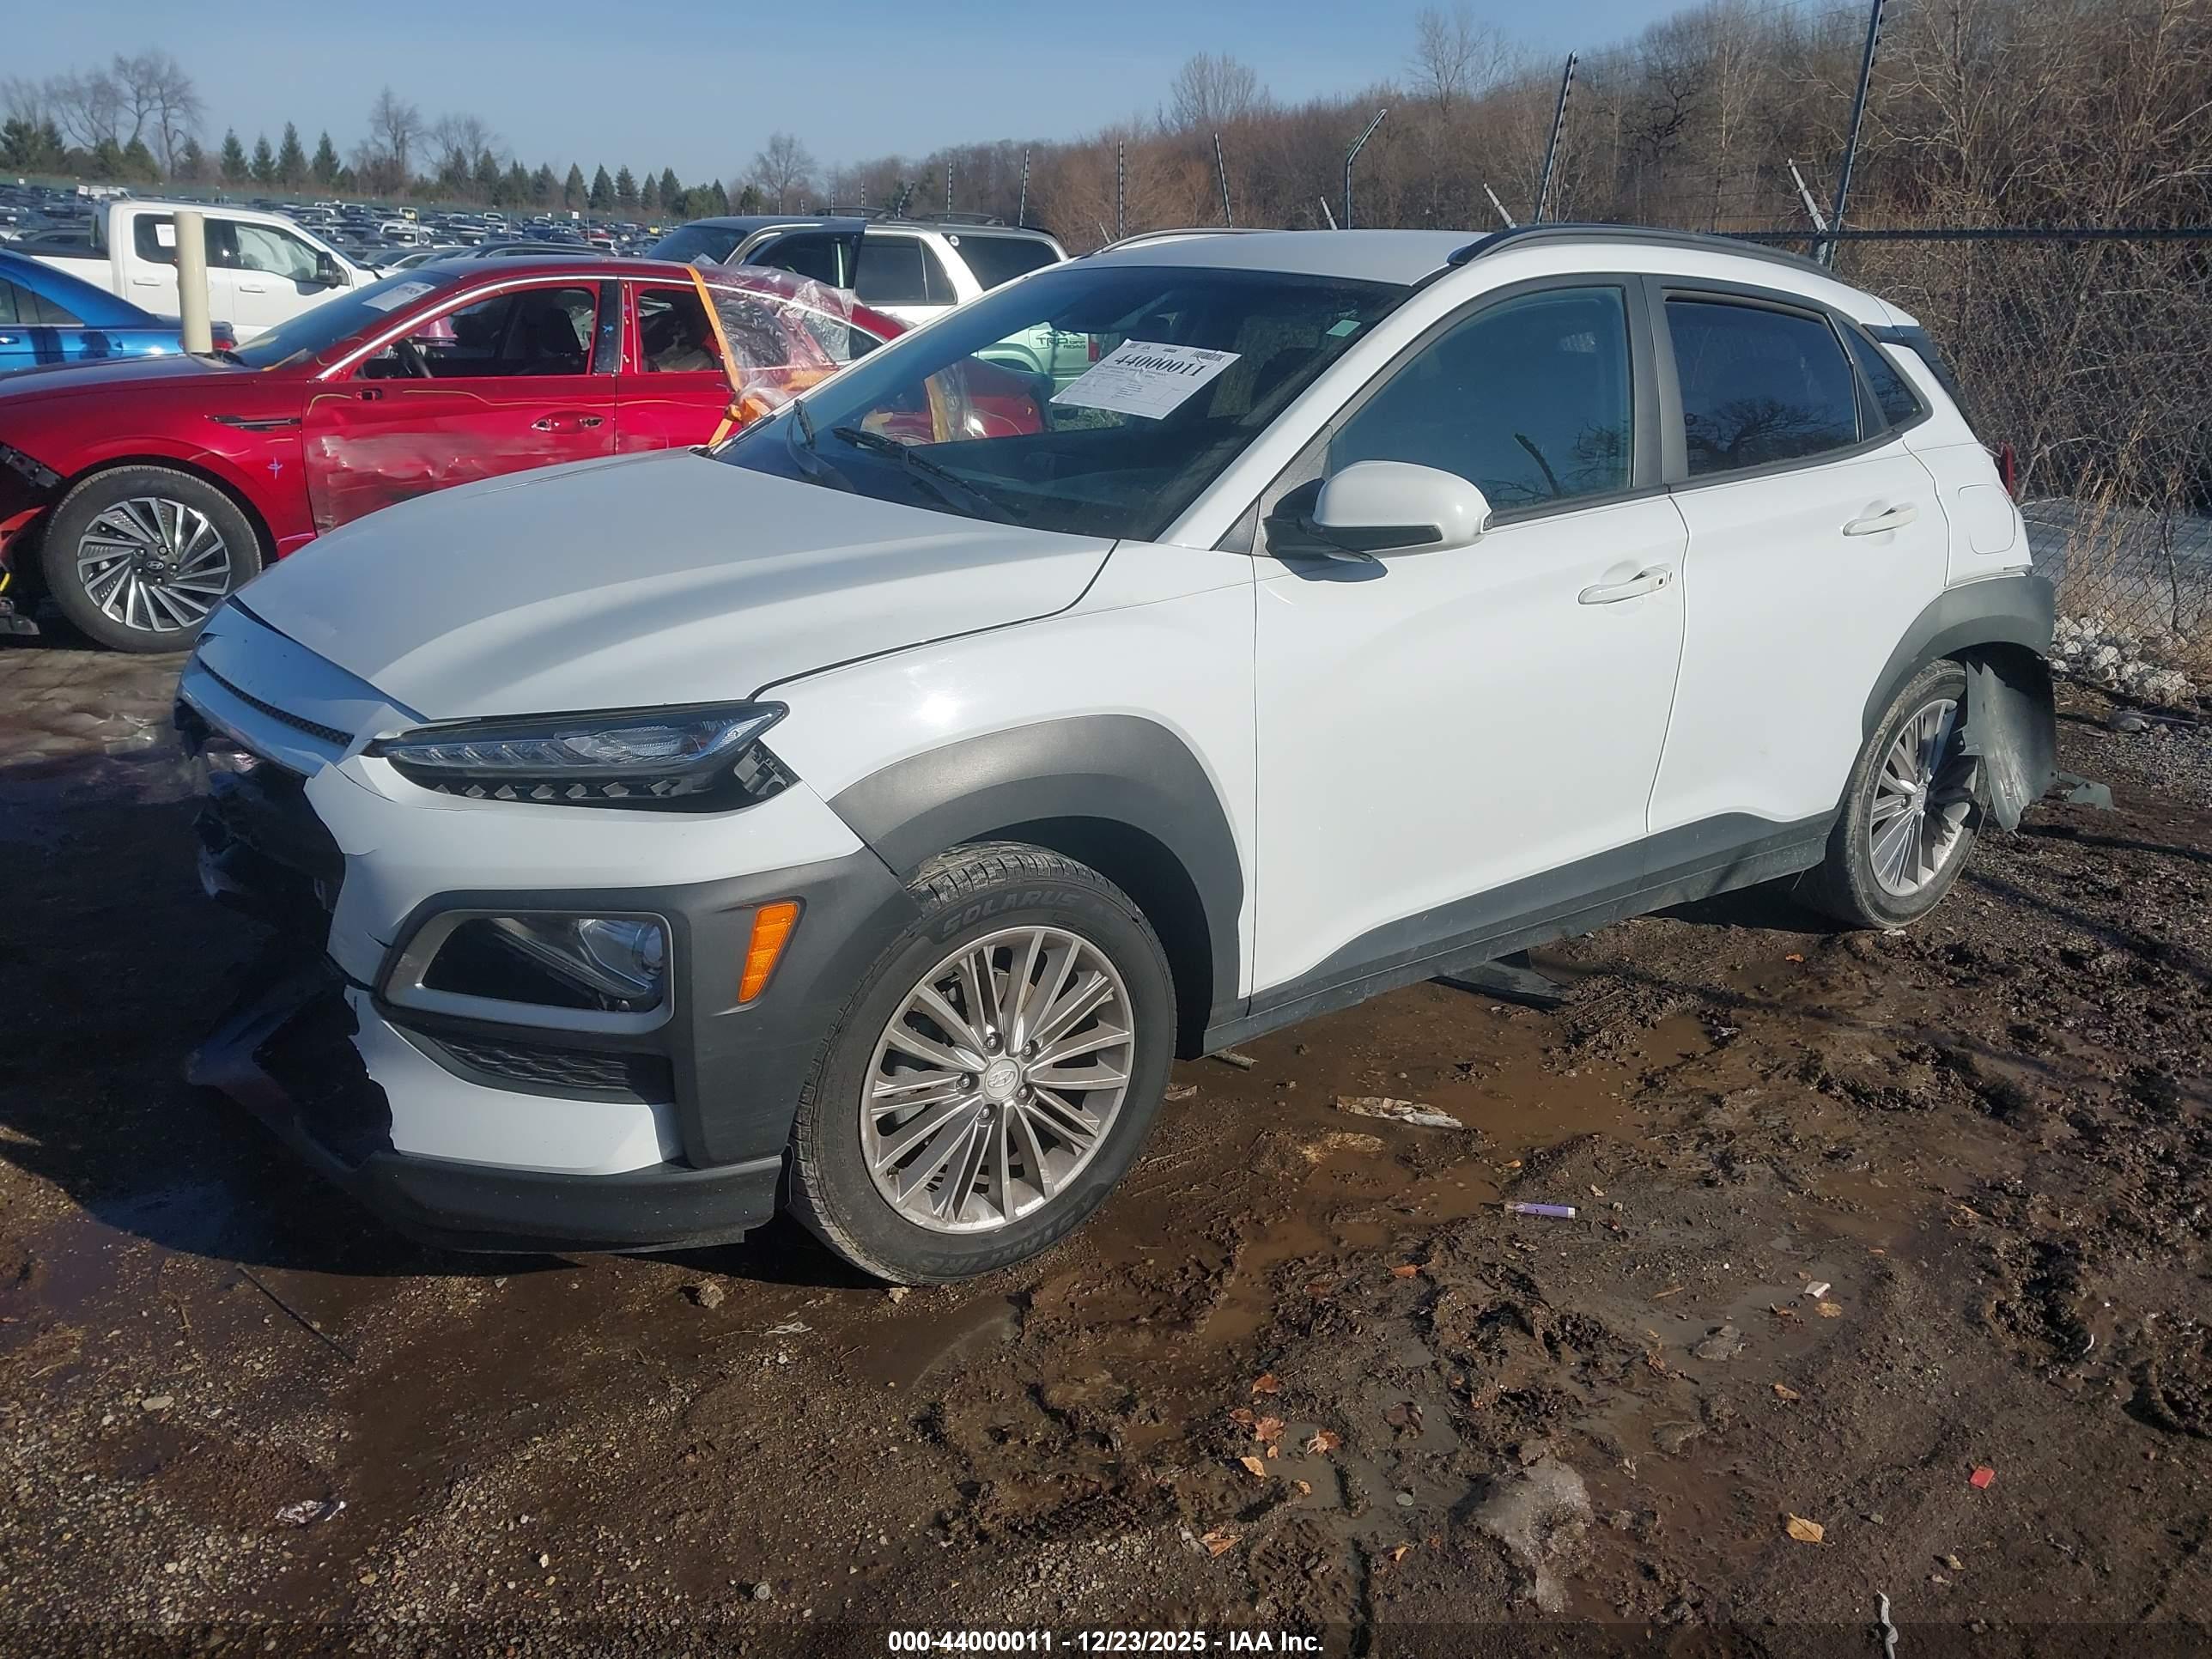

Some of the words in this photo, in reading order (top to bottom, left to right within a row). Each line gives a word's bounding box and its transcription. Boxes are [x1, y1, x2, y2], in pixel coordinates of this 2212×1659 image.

[1036, 337, 1068, 347] TRD
[1114, 353, 1206, 376] 44000011
[942, 890, 1082, 935] SOLARUS
